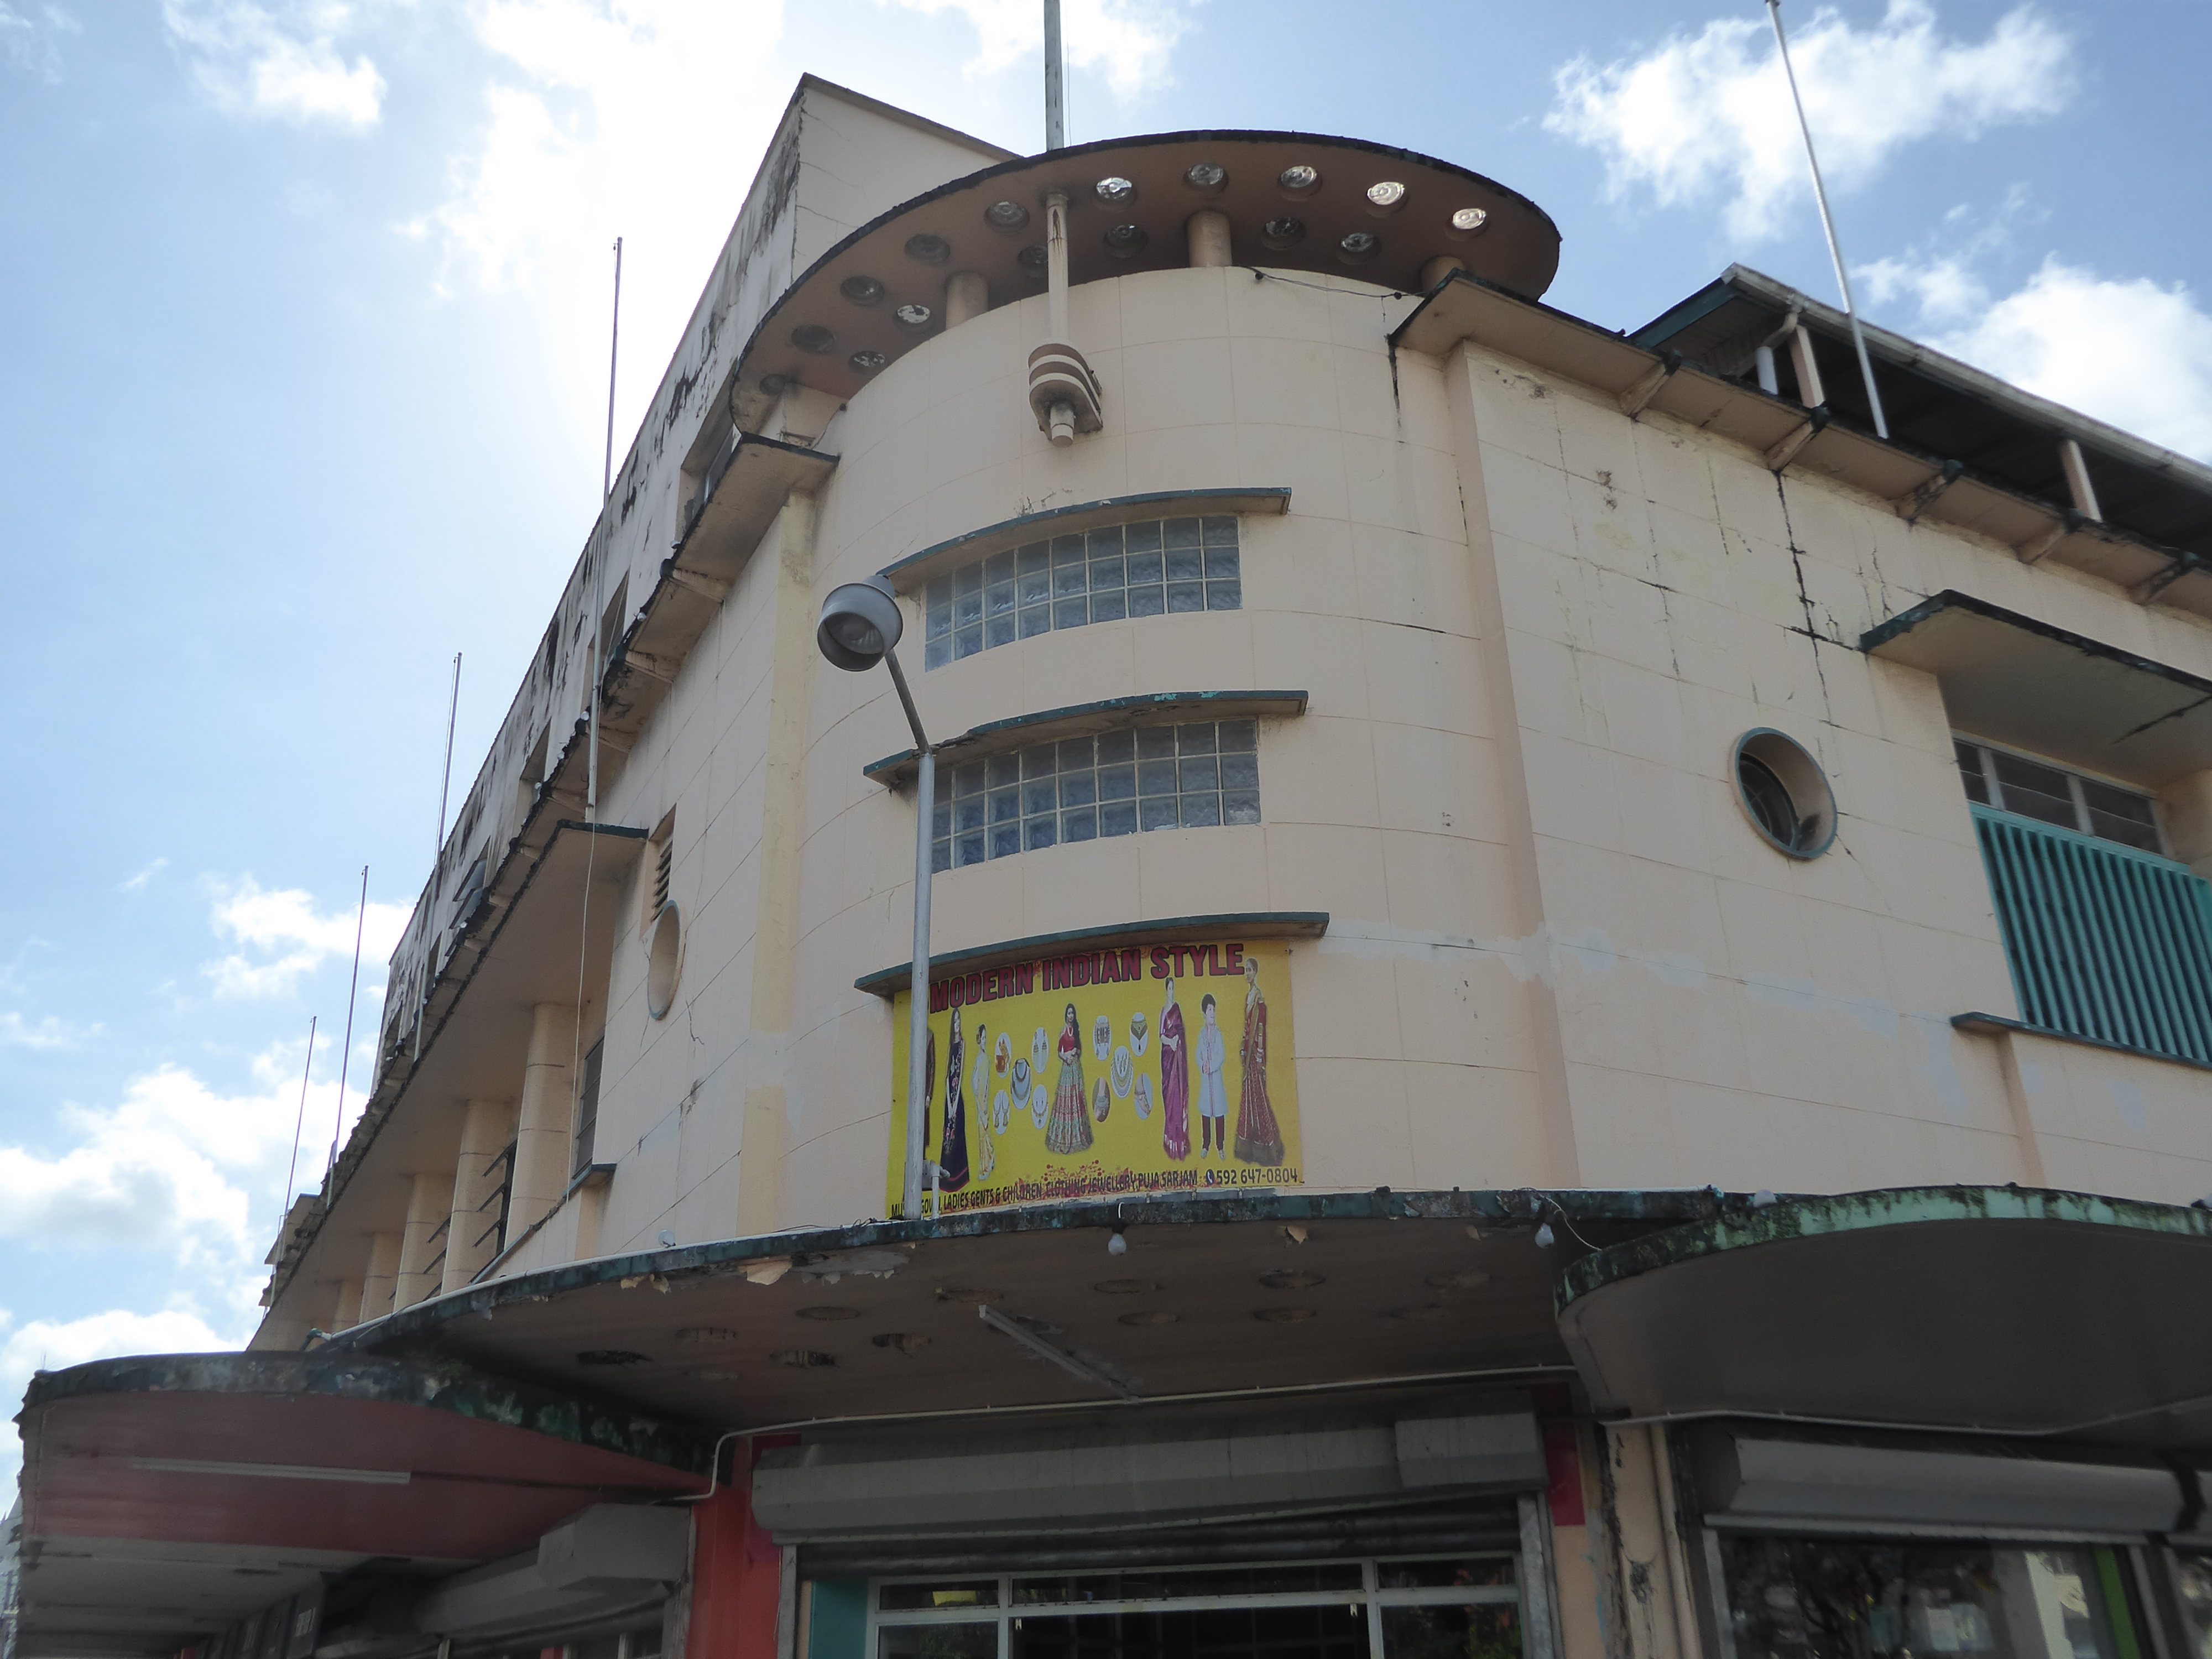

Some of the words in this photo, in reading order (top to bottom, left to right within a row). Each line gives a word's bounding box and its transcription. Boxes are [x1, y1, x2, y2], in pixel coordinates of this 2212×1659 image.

[930, 962, 1034, 1014] MODERN
[1042, 948, 1142, 992] INDIAN
[1150, 943, 1245, 979] STYLE
[1217, 1168, 1237, 1185] 592
[1240, 1167, 1298, 1184] 647-0804
[943, 1192, 969, 1211] LADIES
[971, 1188, 994, 1207] GENTS
[995, 1187, 1000, 1203] &
[1002, 1182, 1042, 1202] CHILDREN
[1046, 1177, 1086, 1198] CLOTHING
